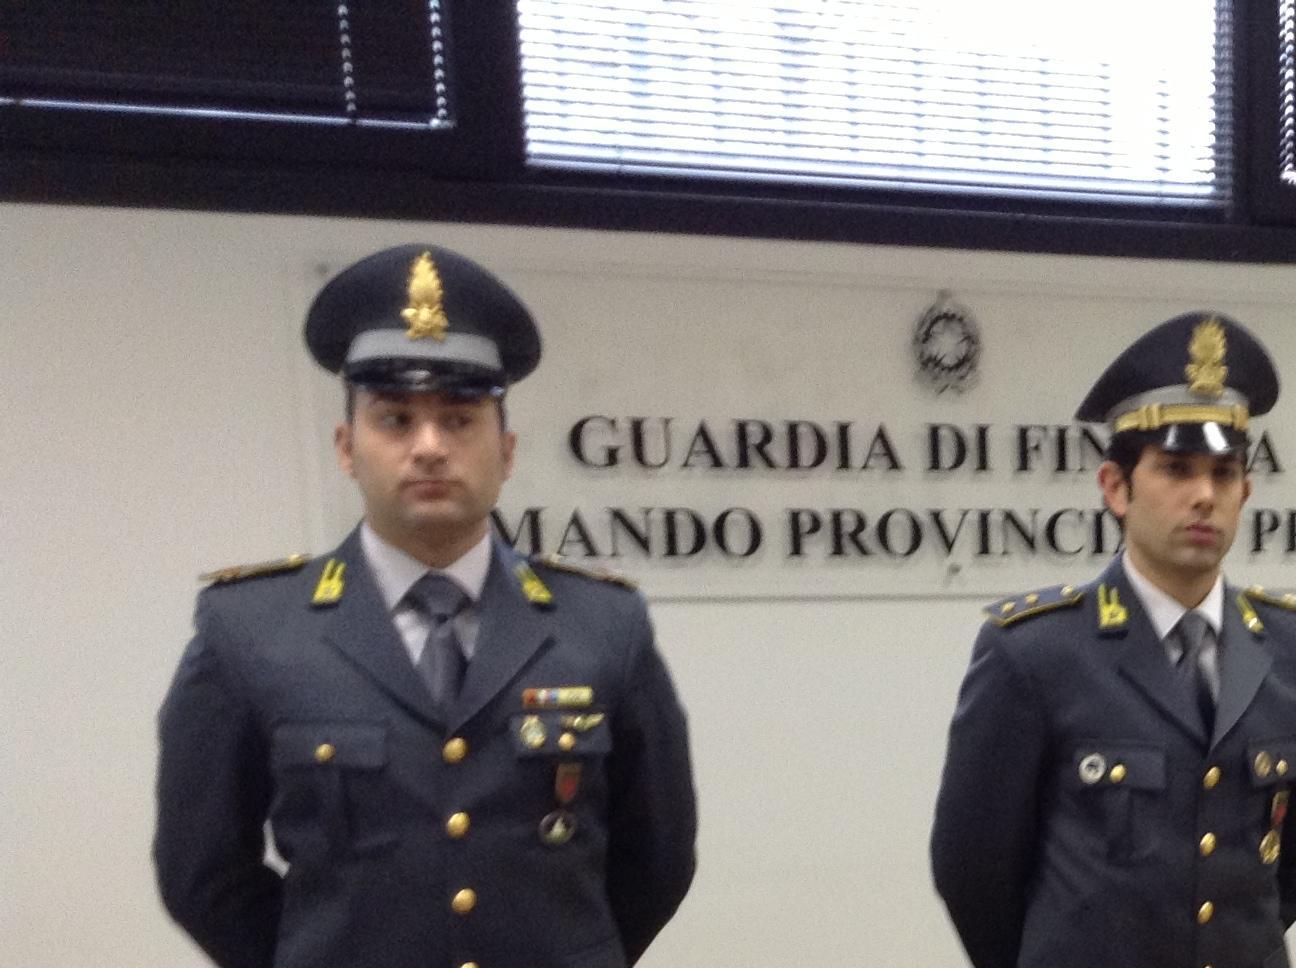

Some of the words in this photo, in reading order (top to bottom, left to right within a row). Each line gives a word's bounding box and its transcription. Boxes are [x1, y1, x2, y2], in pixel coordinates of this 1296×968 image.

[567, 415, 905, 471] GUARDIA
[926, 422, 989, 472] DI
[1016, 423, 1285, 474] FINA
[490, 506, 763, 557] MANDO
